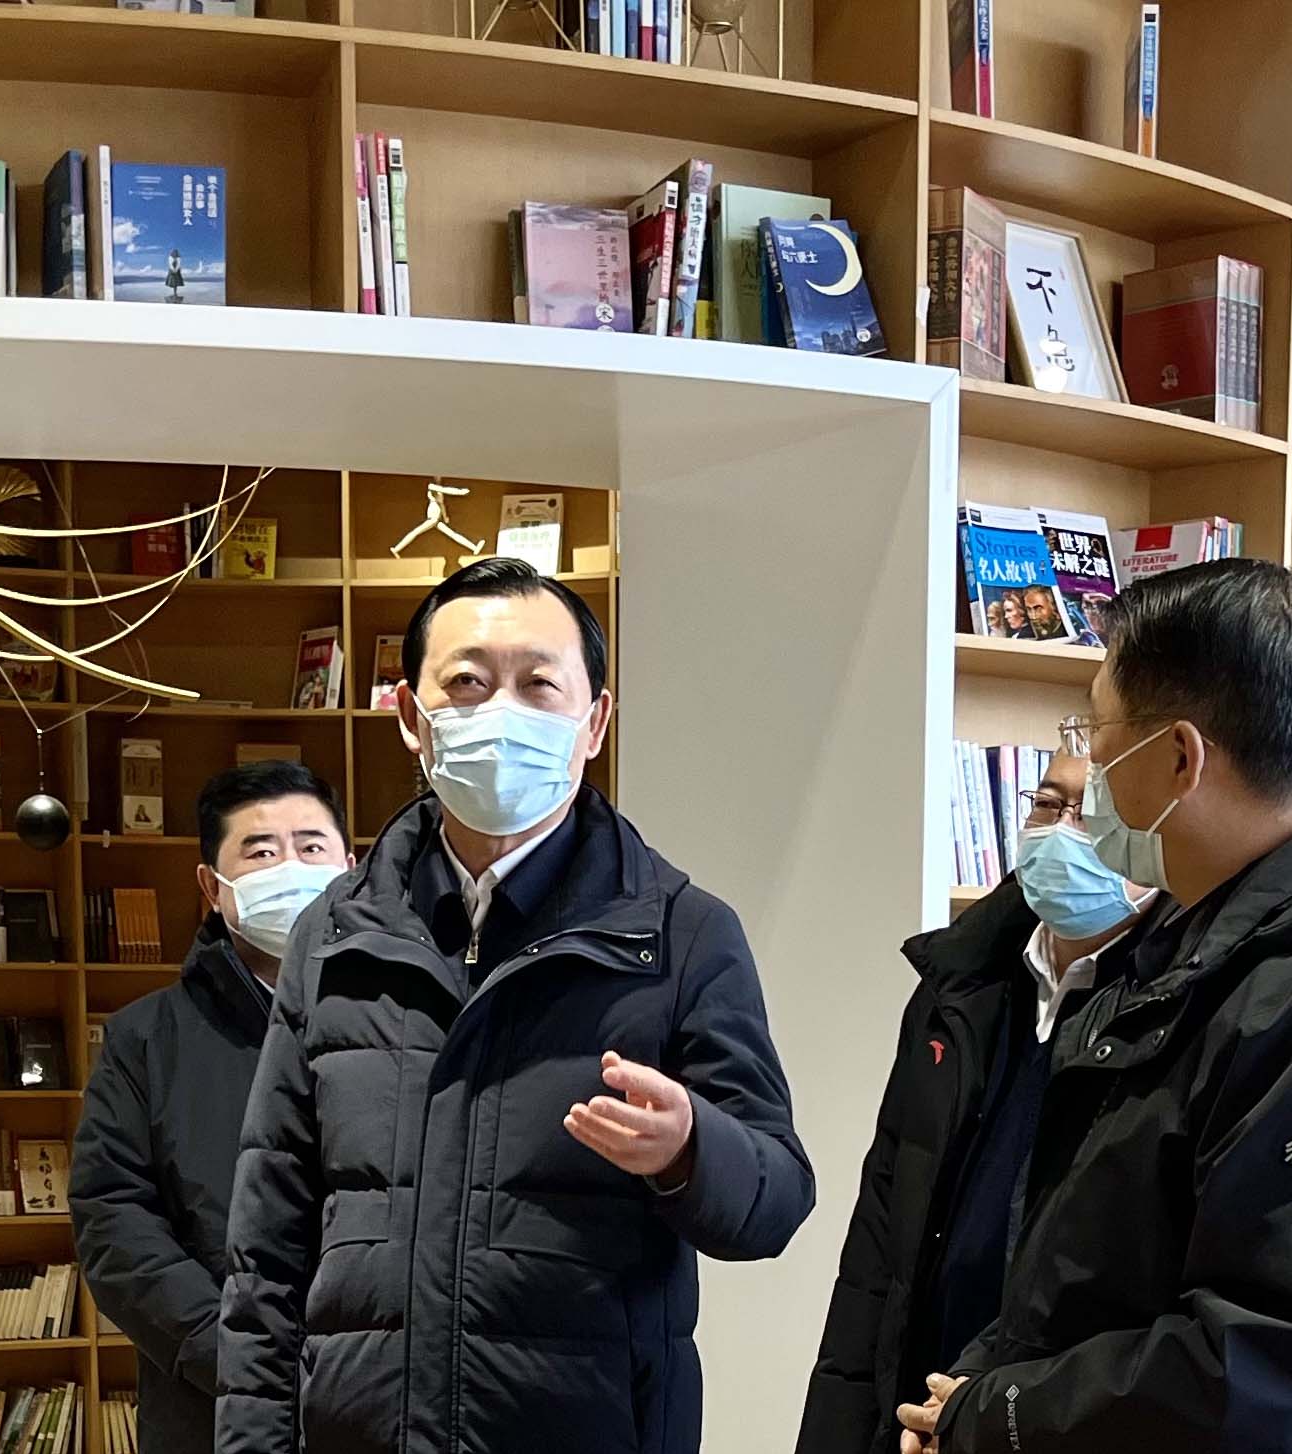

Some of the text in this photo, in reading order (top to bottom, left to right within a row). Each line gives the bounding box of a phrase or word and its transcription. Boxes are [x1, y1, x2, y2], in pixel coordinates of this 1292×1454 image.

[975, 531, 1039, 559] Stories
[1058, 531, 1093, 554] 世界
[978, 556, 1038, 584] 名人故事
[1050, 552, 1111, 578] 未解之谜
[1122, 553, 1180, 567] LITERATURE
